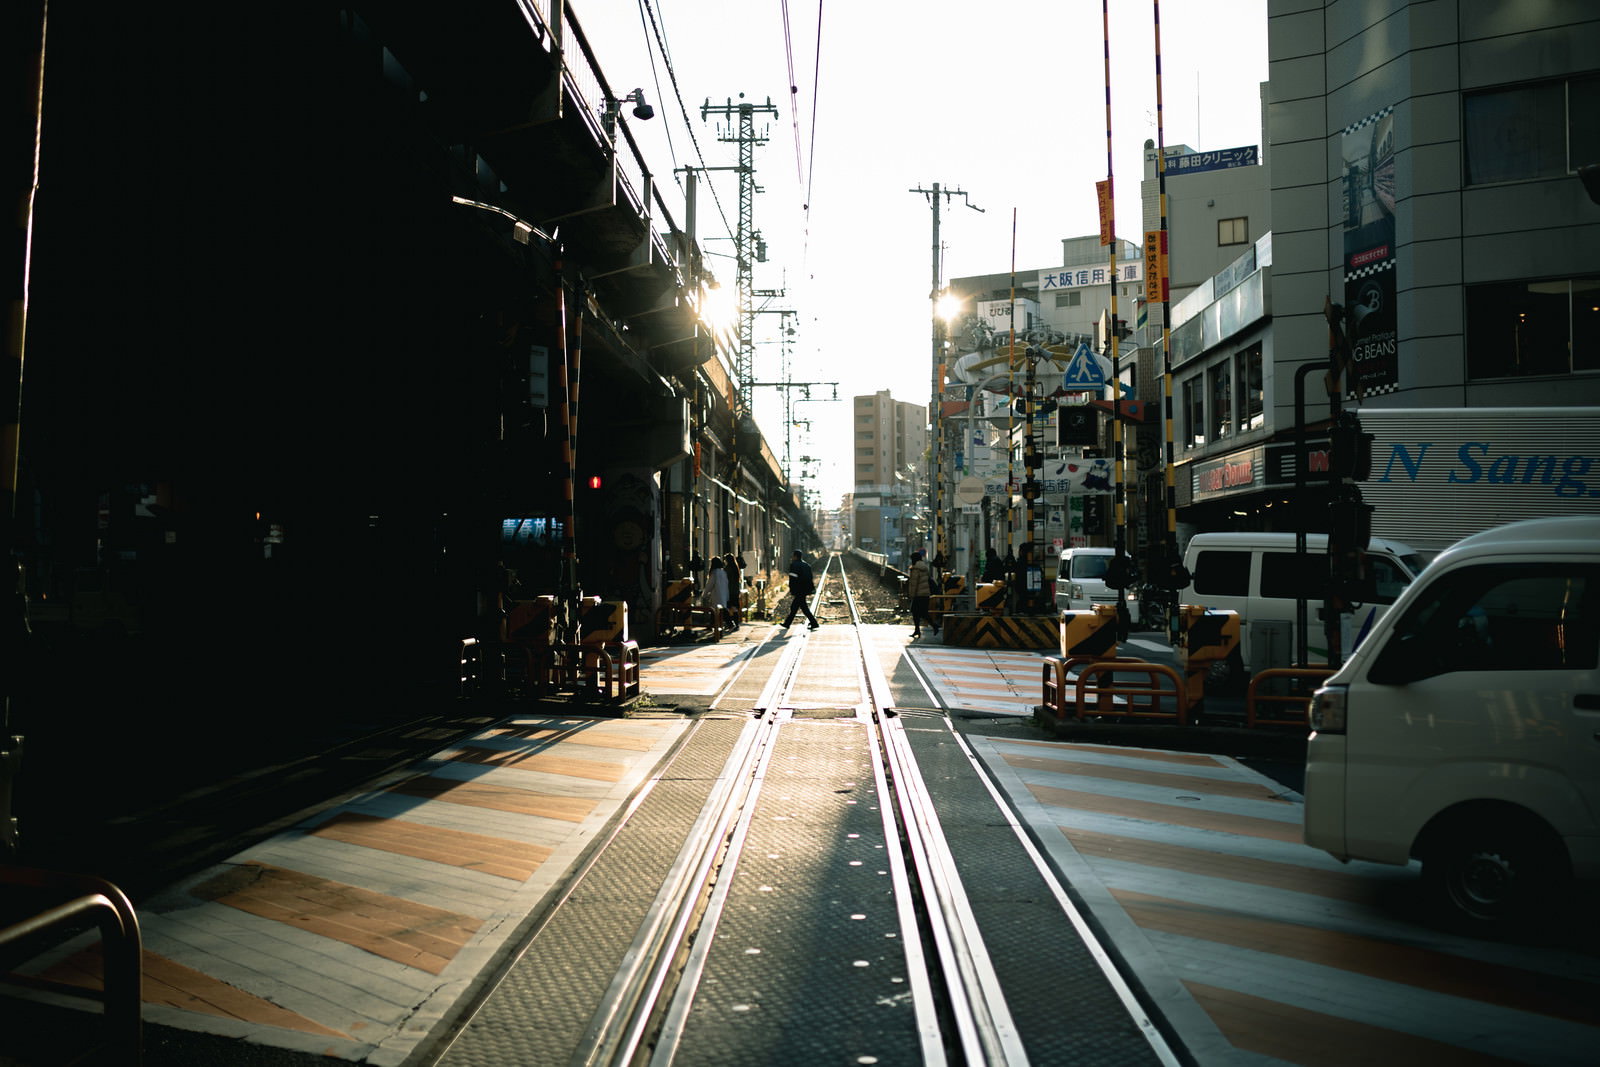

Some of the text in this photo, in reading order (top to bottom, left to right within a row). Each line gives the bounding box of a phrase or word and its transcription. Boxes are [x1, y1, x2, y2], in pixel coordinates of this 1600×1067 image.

[1178, 147, 1255, 169] 藤田クリニック
[1147, 234, 1159, 300] おまちください
[1365, 338, 1396, 360] BEANS
[1378, 443, 1432, 482] N
